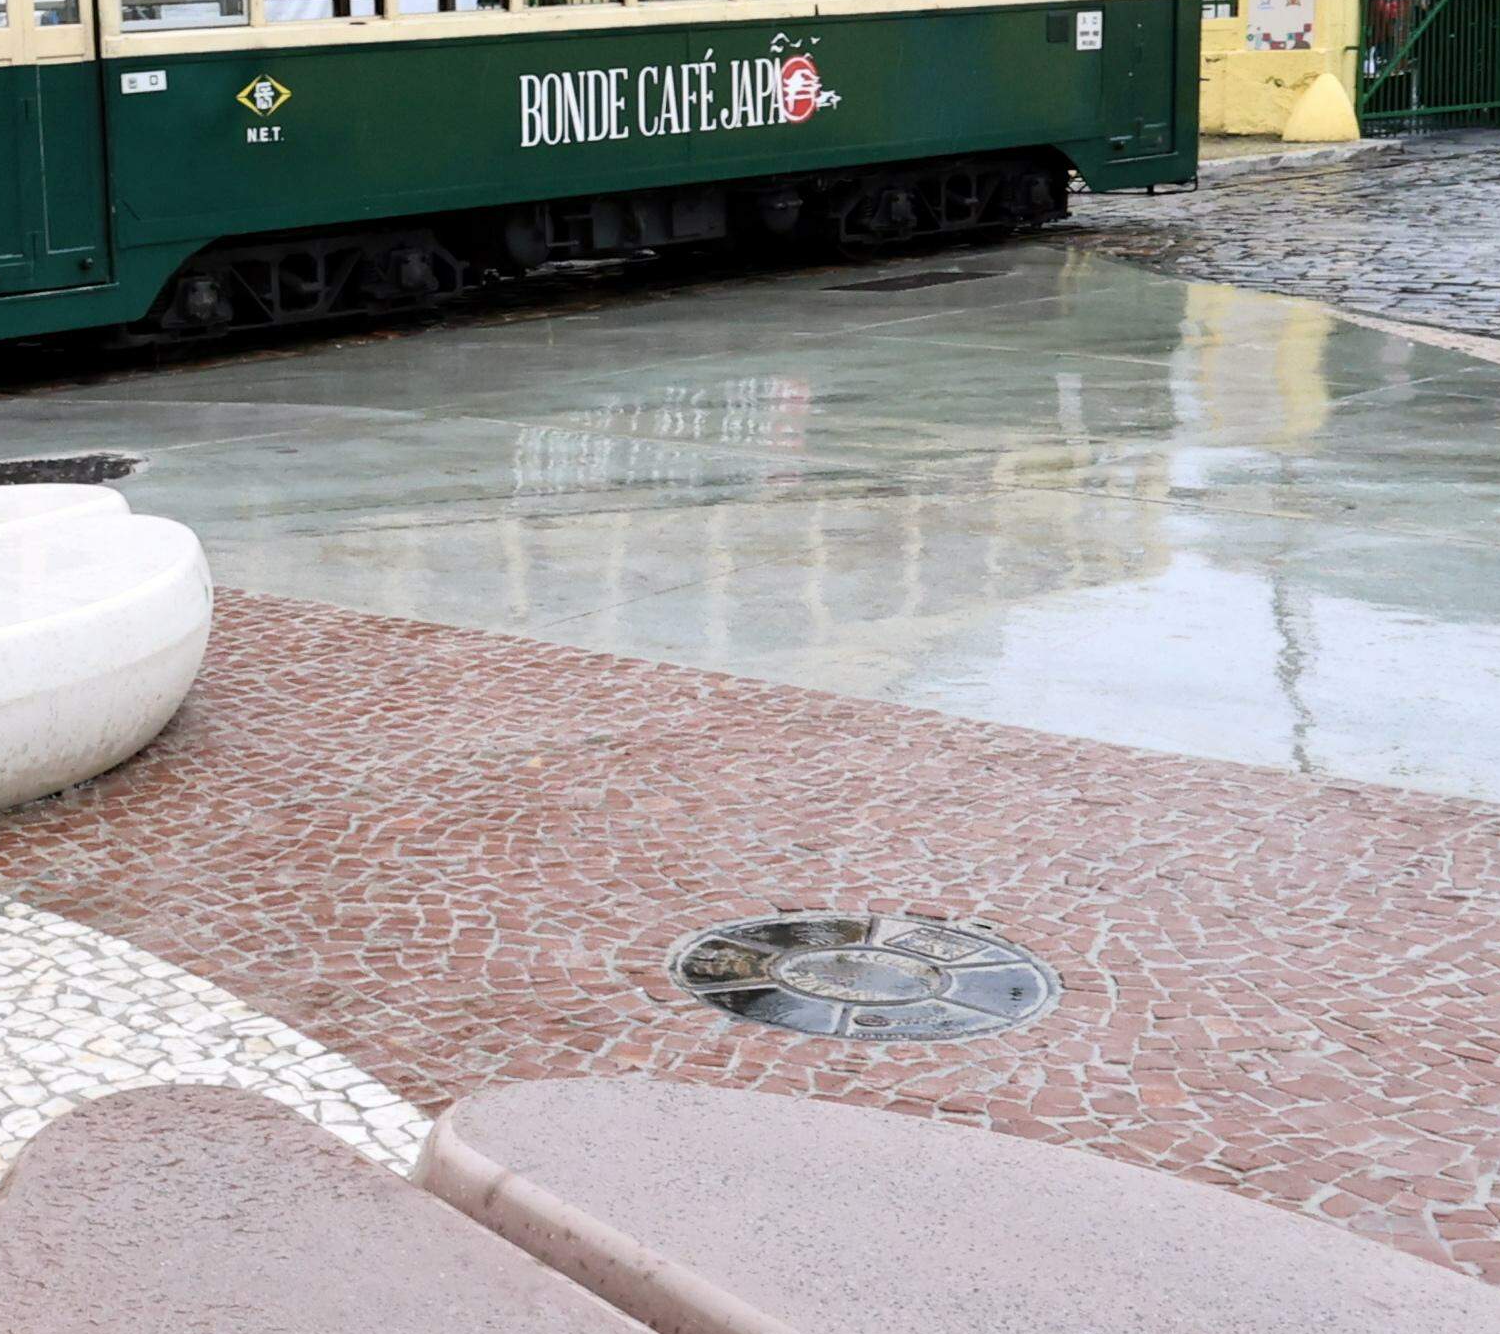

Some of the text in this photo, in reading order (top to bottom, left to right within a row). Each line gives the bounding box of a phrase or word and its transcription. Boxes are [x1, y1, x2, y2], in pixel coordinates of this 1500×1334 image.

[519, 68, 629, 147] BONDE
[638, 48, 717, 137] CAFÉ
[246, 126, 285, 143] N.E.T.
